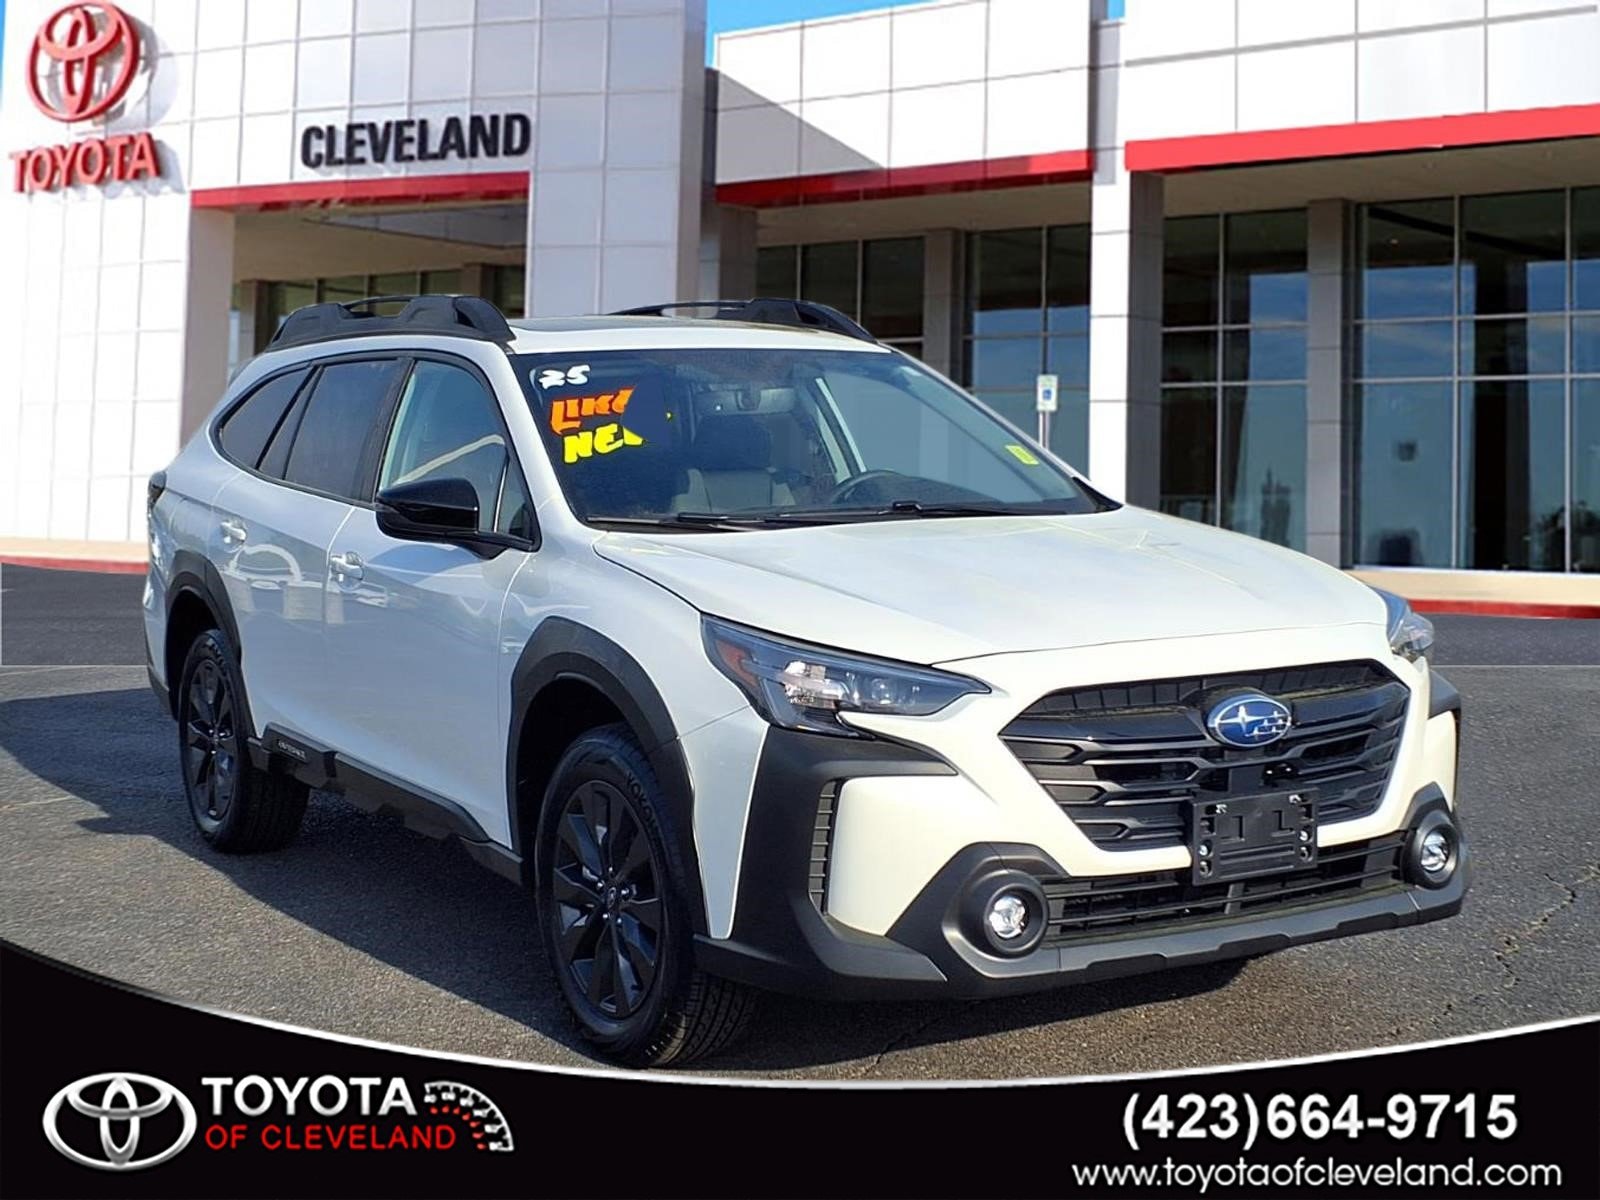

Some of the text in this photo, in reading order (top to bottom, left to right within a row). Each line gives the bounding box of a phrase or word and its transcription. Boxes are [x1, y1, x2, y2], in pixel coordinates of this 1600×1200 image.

[9, 131, 160, 193] TOYOTA
[301, 113, 531, 169] CLEVELAND
[538, 364, 591, 390] 25
